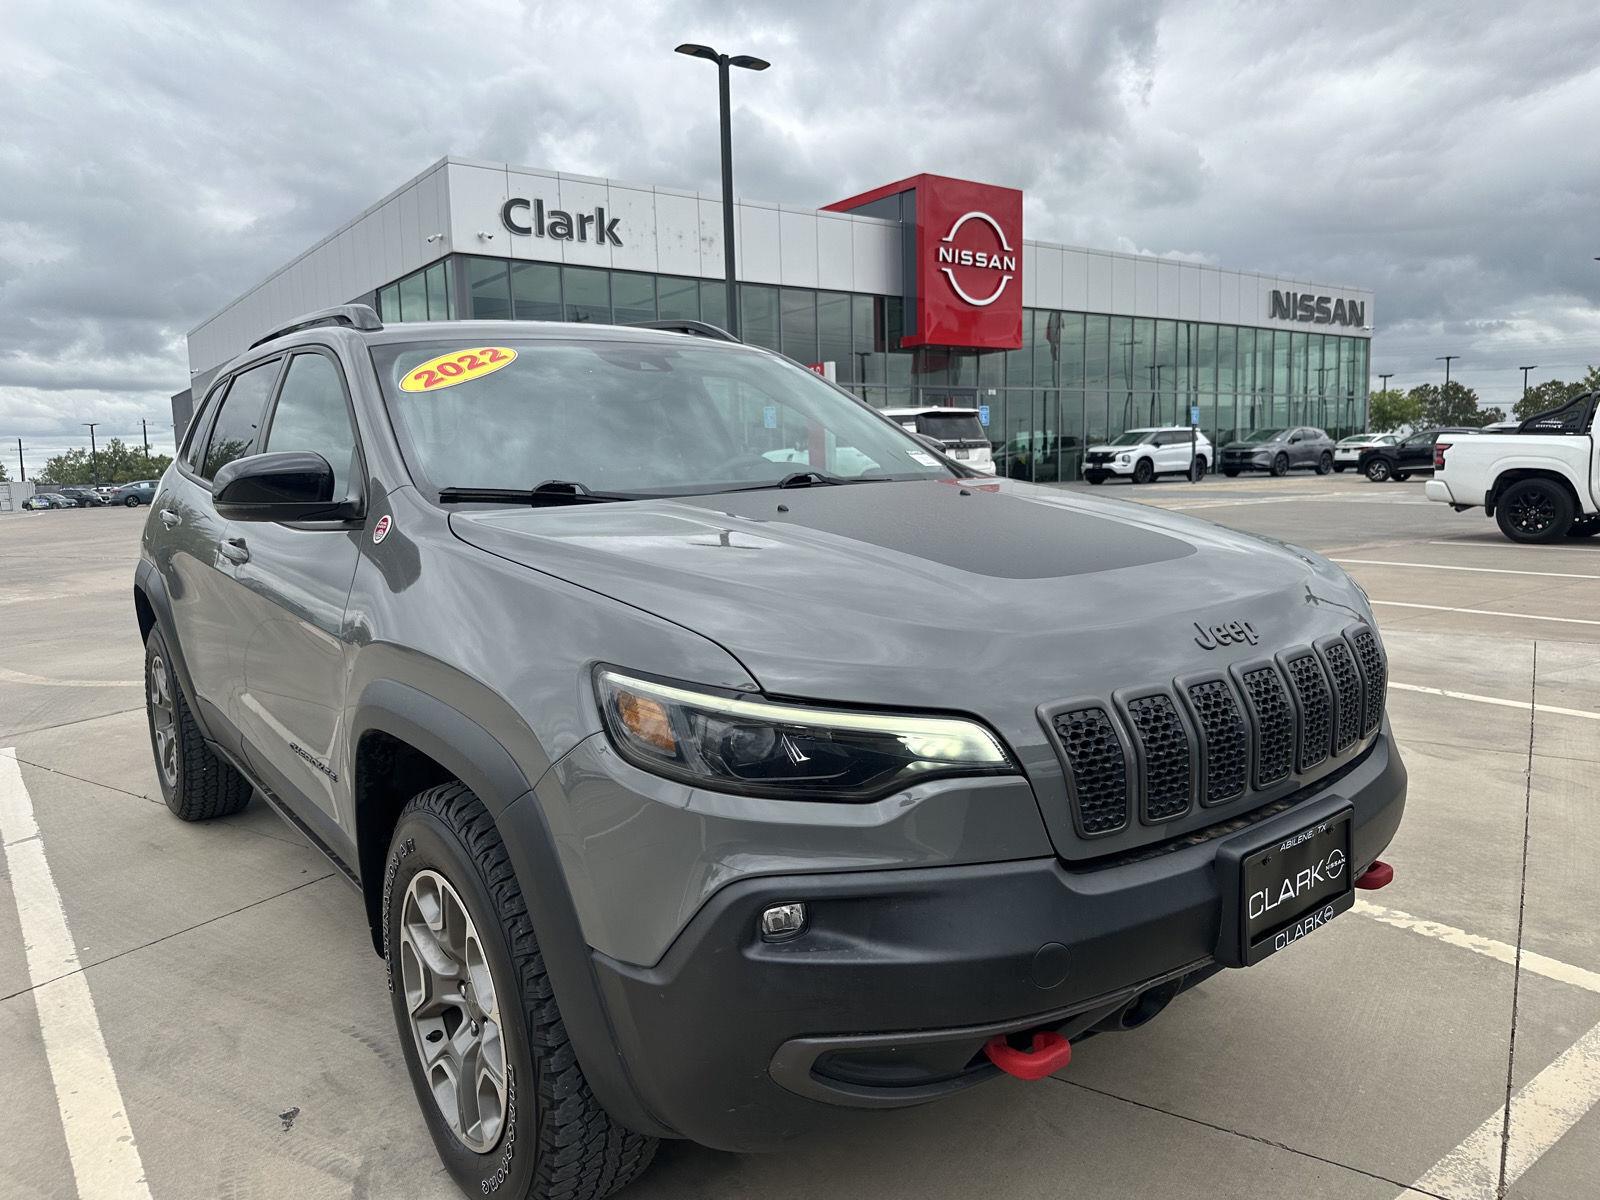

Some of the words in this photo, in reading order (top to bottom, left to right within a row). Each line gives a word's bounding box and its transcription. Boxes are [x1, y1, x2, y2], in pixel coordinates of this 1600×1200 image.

[501, 198, 623, 247] Clark
[939, 246, 1016, 271] NISSAN
[1269, 289, 1365, 327] NISSAN
[414, 348, 508, 388] 2022
[1193, 620, 1259, 650] Jeep
[1317, 823, 1327, 834] TX
[1249, 859, 1325, 920] CLARK
[1274, 910, 1324, 951] CLARK
